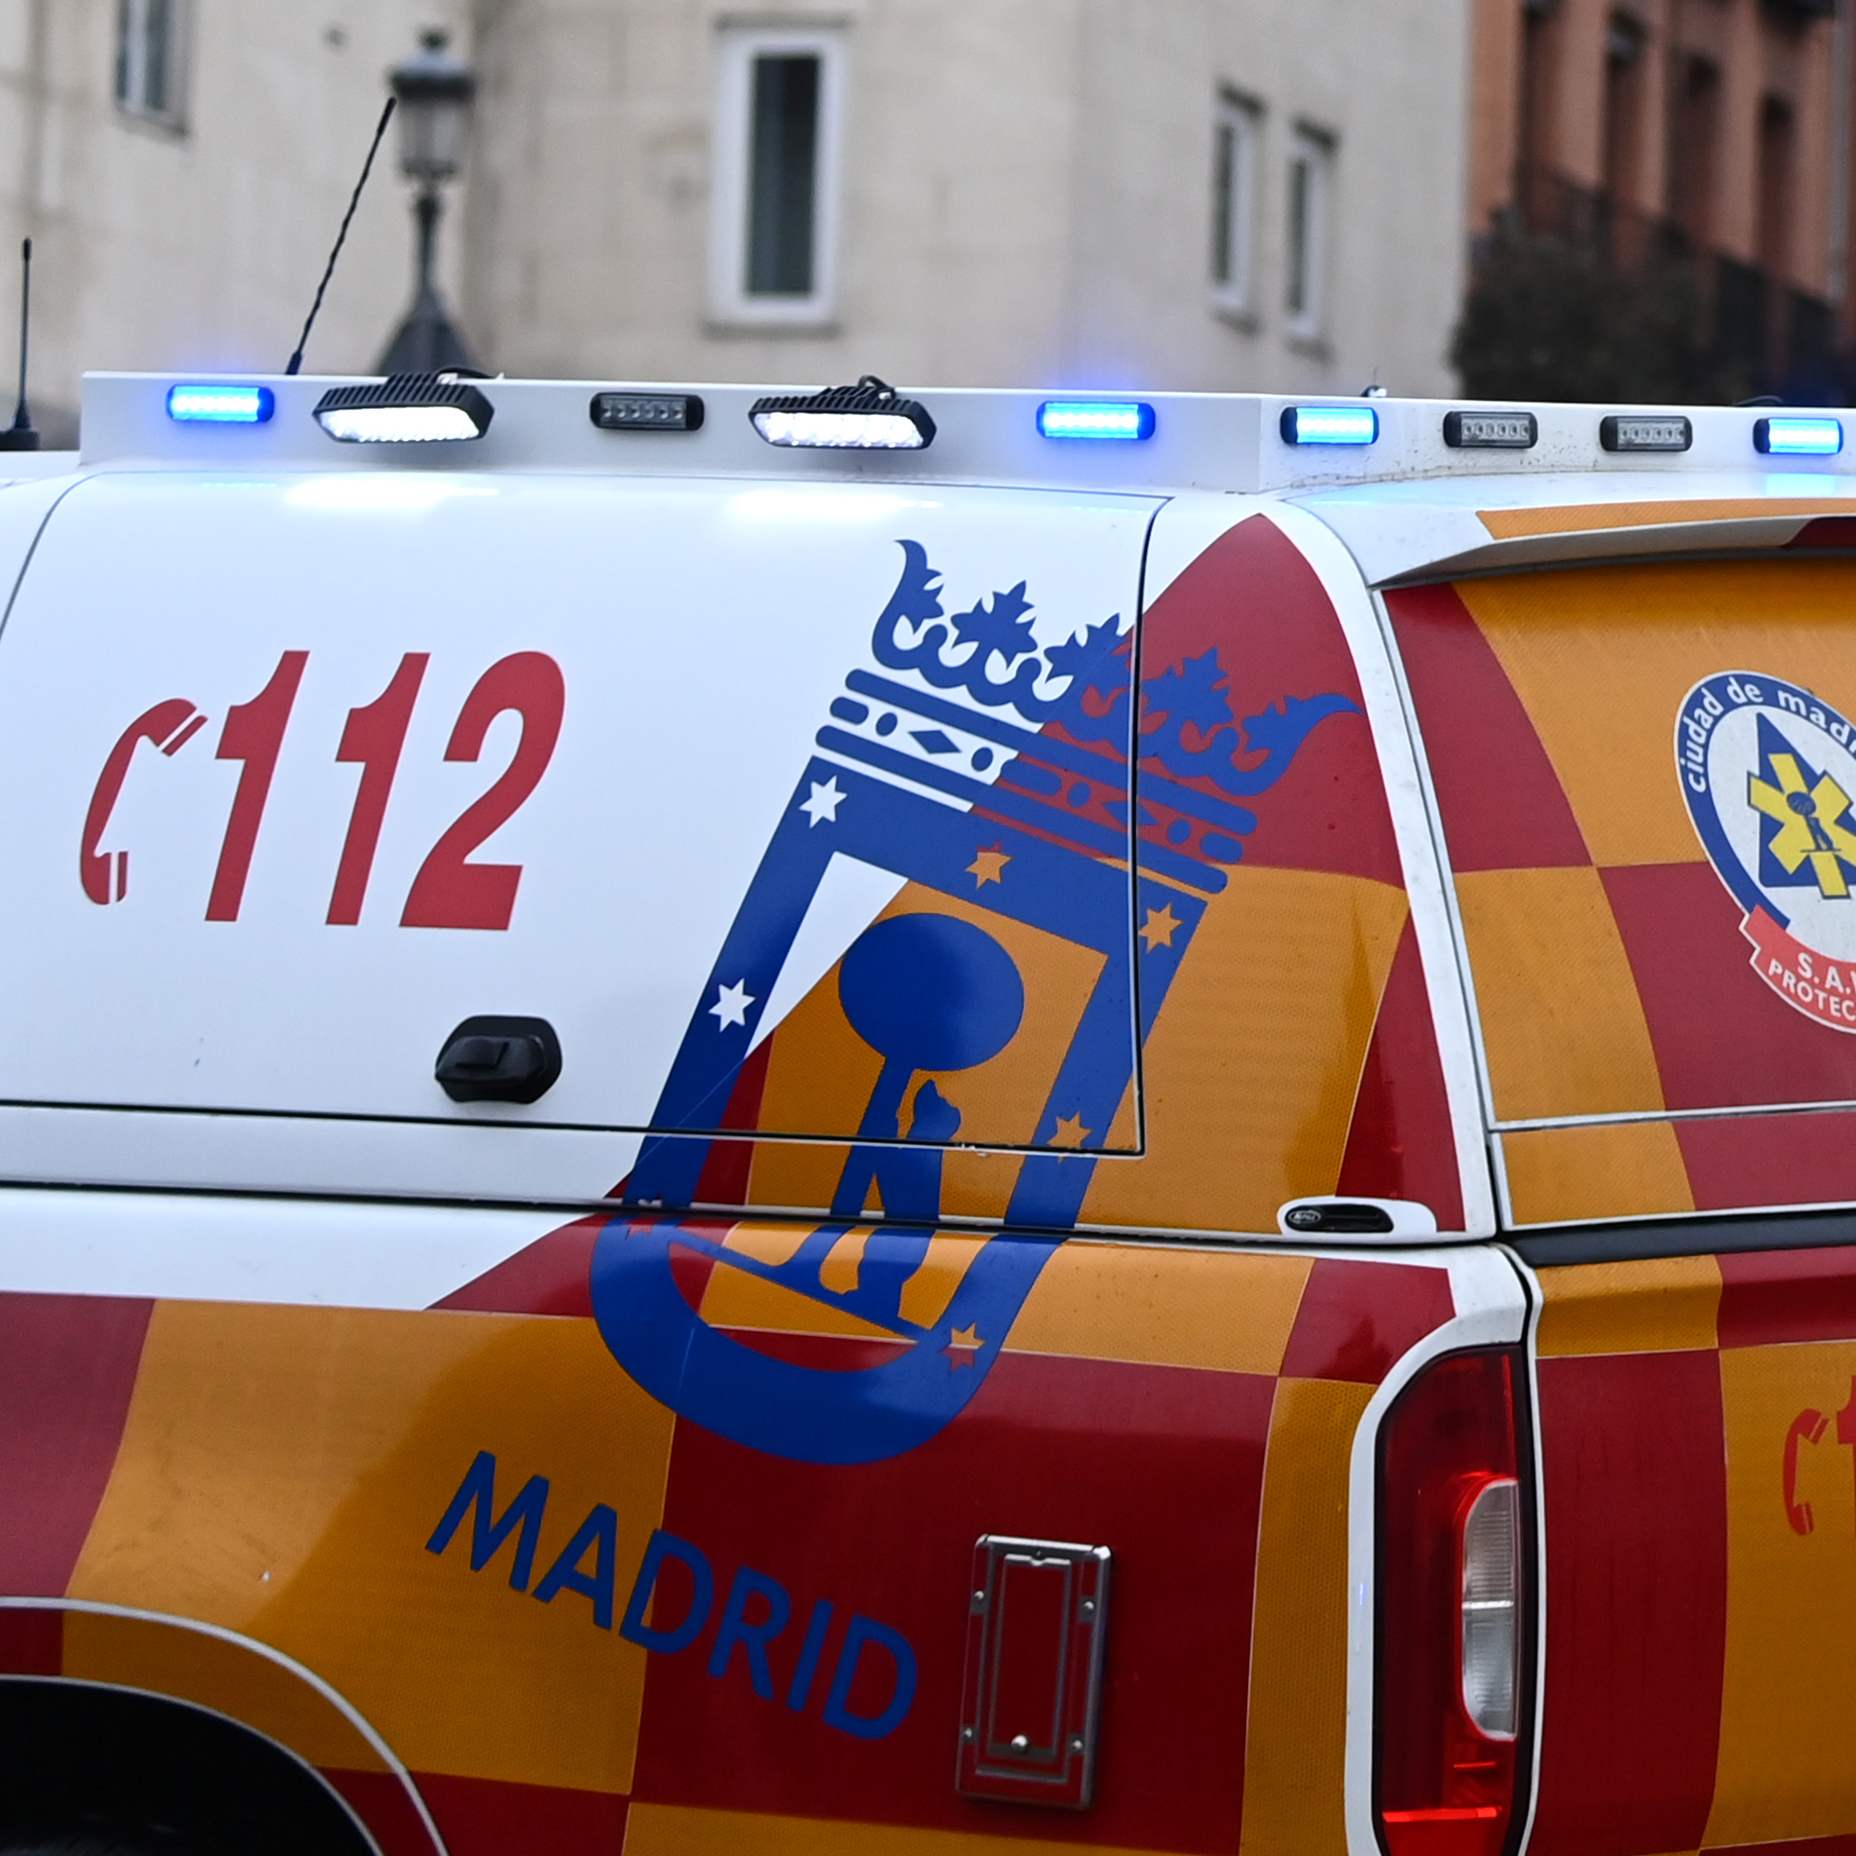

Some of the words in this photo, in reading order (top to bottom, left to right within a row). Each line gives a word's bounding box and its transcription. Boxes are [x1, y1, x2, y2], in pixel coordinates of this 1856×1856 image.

[205, 650, 566, 931] 112
[1679, 688, 1724, 793] ciudad
[1726, 676, 1764, 704] de
[425, 1450, 918, 1741] MADRID
